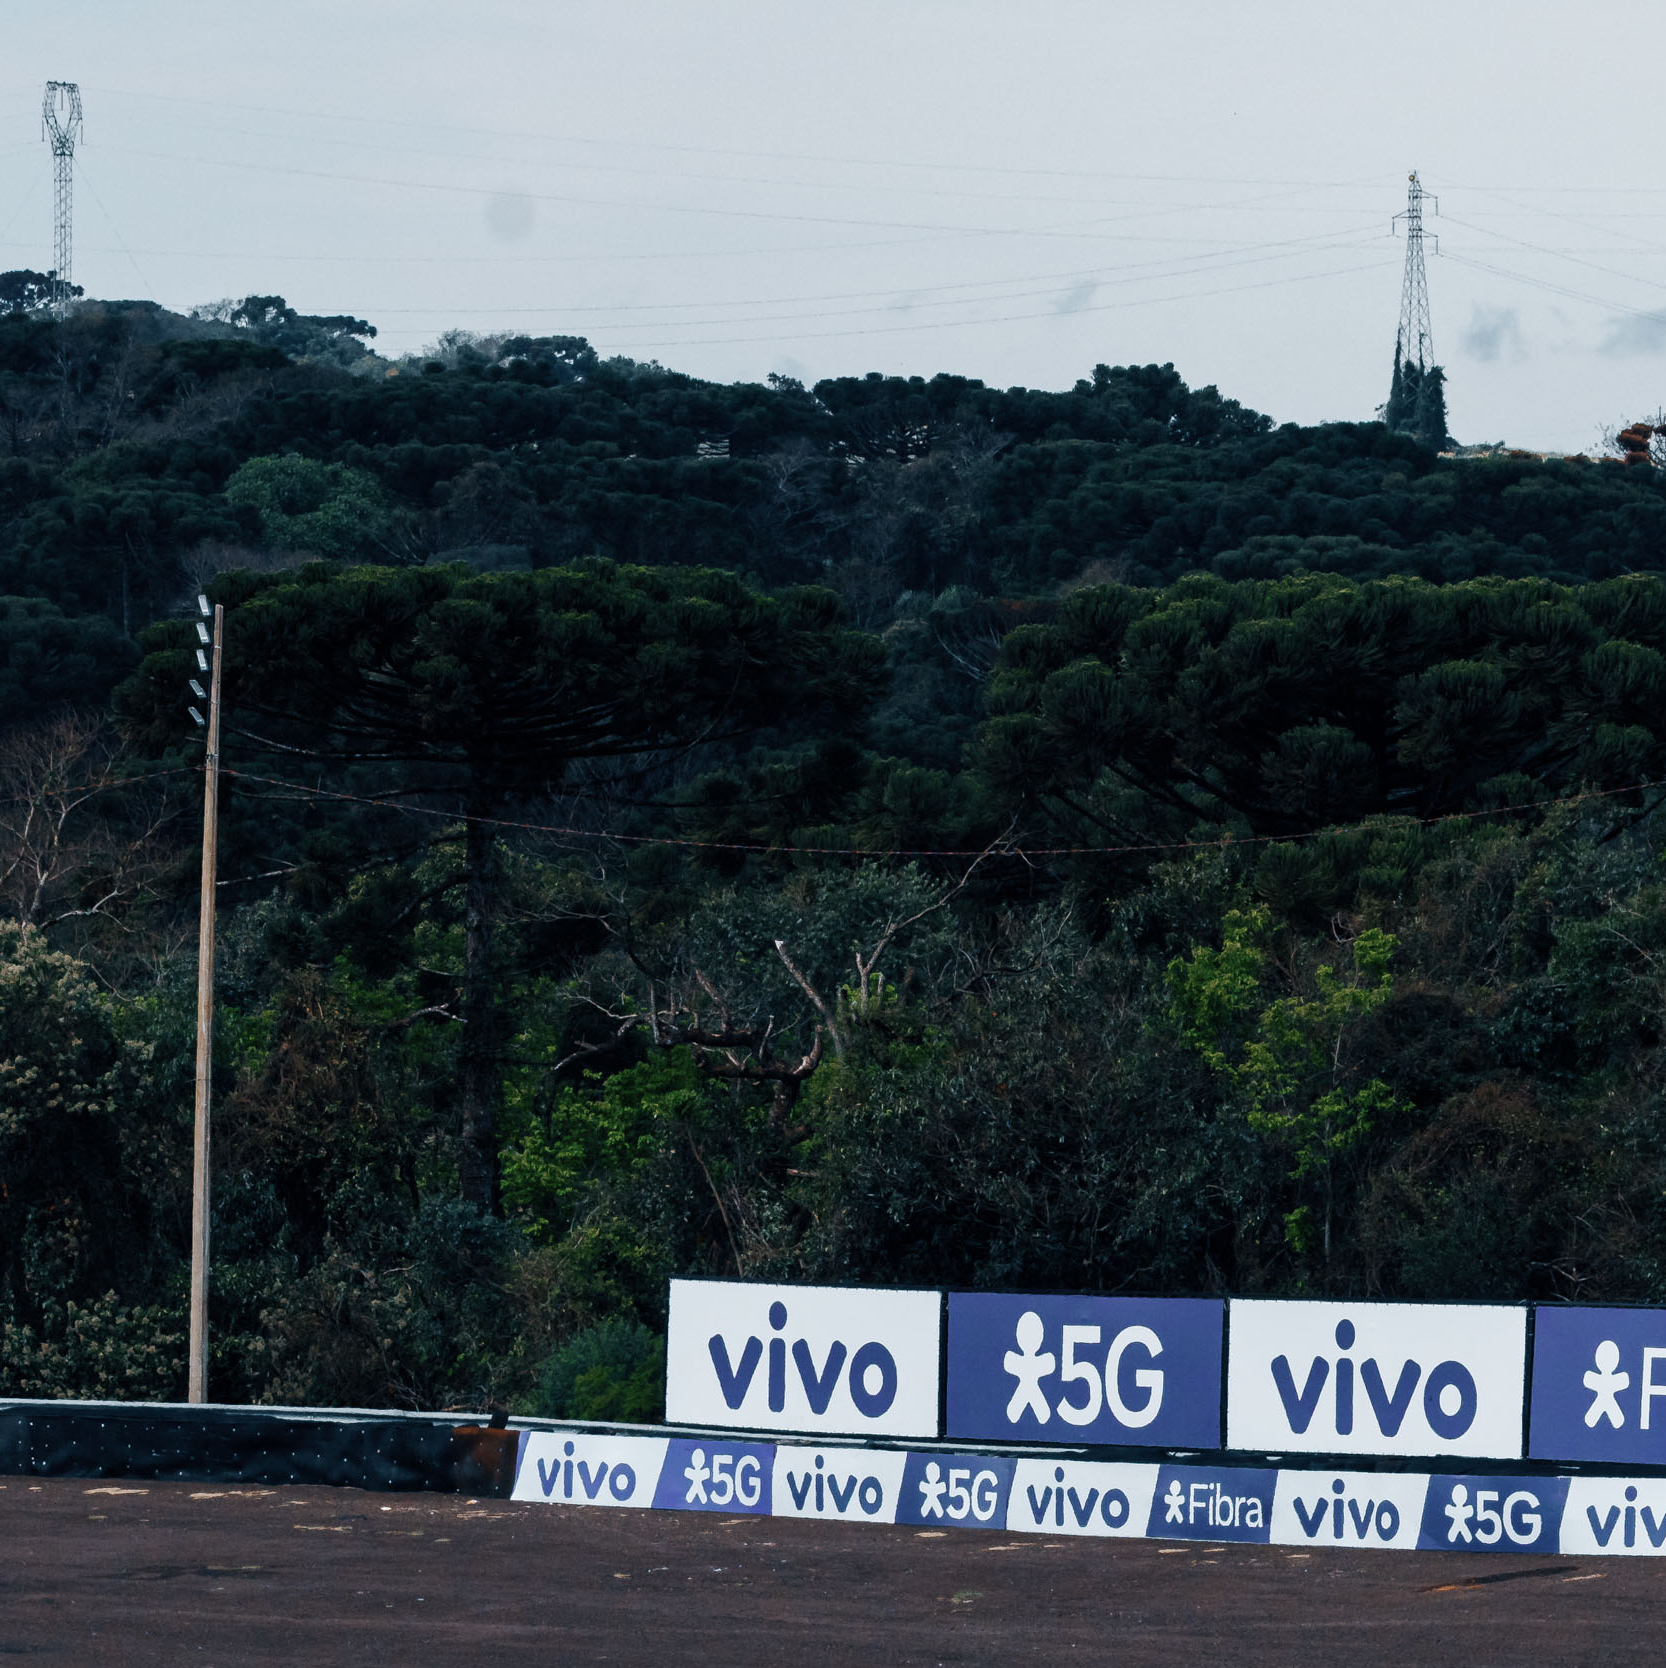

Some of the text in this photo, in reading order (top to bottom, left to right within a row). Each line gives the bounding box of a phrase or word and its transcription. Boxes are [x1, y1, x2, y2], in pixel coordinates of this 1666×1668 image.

[708, 1300, 898, 1419] vivo
[1055, 1323, 1165, 1429] 5G
[1270, 1318, 1478, 1440] vivo
[536, 1440, 635, 1502] vivo
[708, 1454, 762, 1506] 5G
[785, 1454, 883, 1515] vivo
[941, 1467, 1000, 1522] 5G
[1026, 1466, 1131, 1529] vivo
[1188, 1482, 1263, 1530] Fibra
[1292, 1478, 1400, 1542] vivo
[1475, 1490, 1542, 1545] 5G
